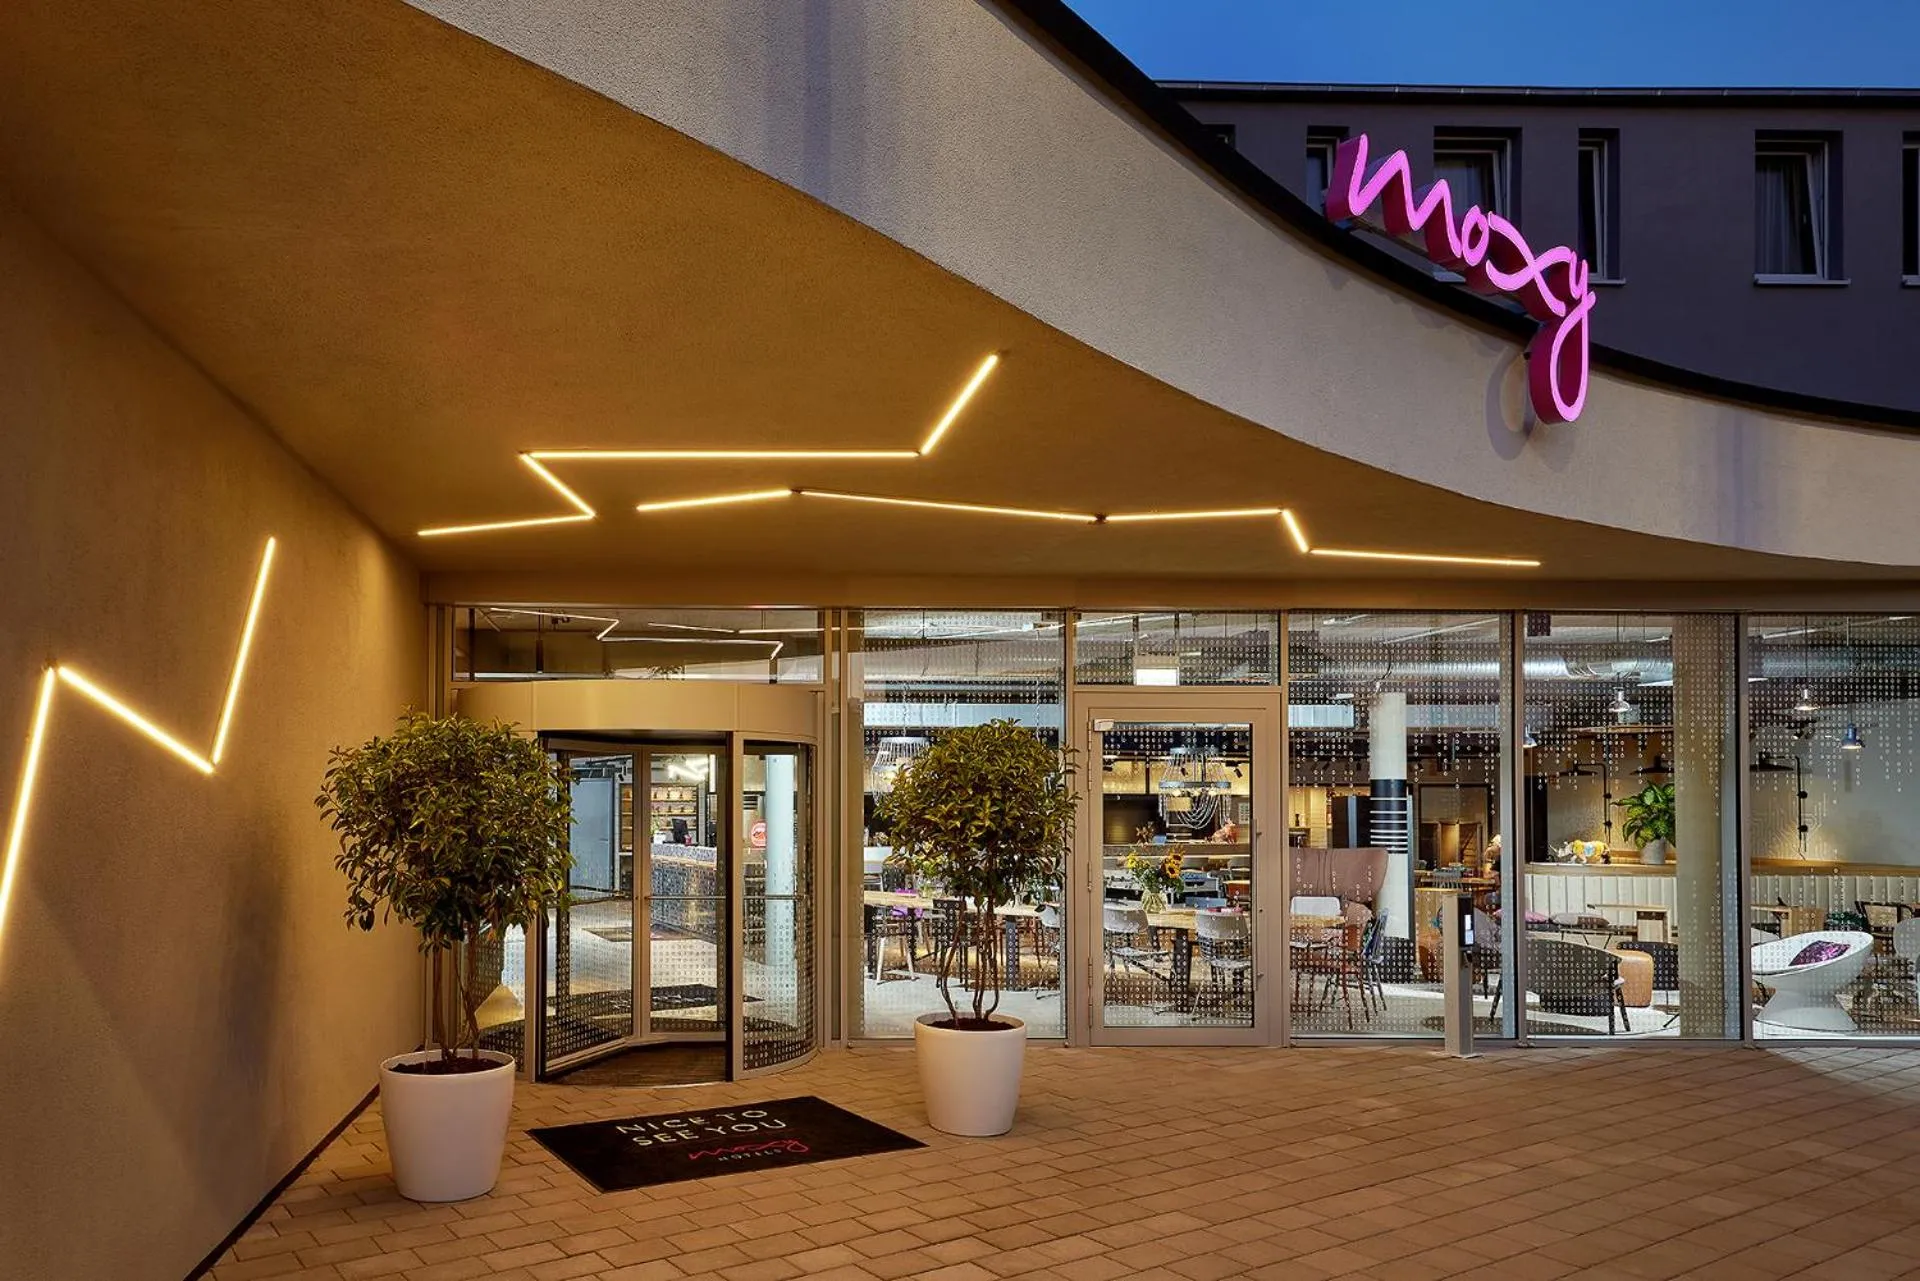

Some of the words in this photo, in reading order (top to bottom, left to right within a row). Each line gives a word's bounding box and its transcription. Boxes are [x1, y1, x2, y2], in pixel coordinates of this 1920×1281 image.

[615, 1116, 711, 1135] NICE
[716, 1109, 768, 1121] TO
[632, 1128, 700, 1147] SEE
[704, 1118, 787, 1135] YOU
